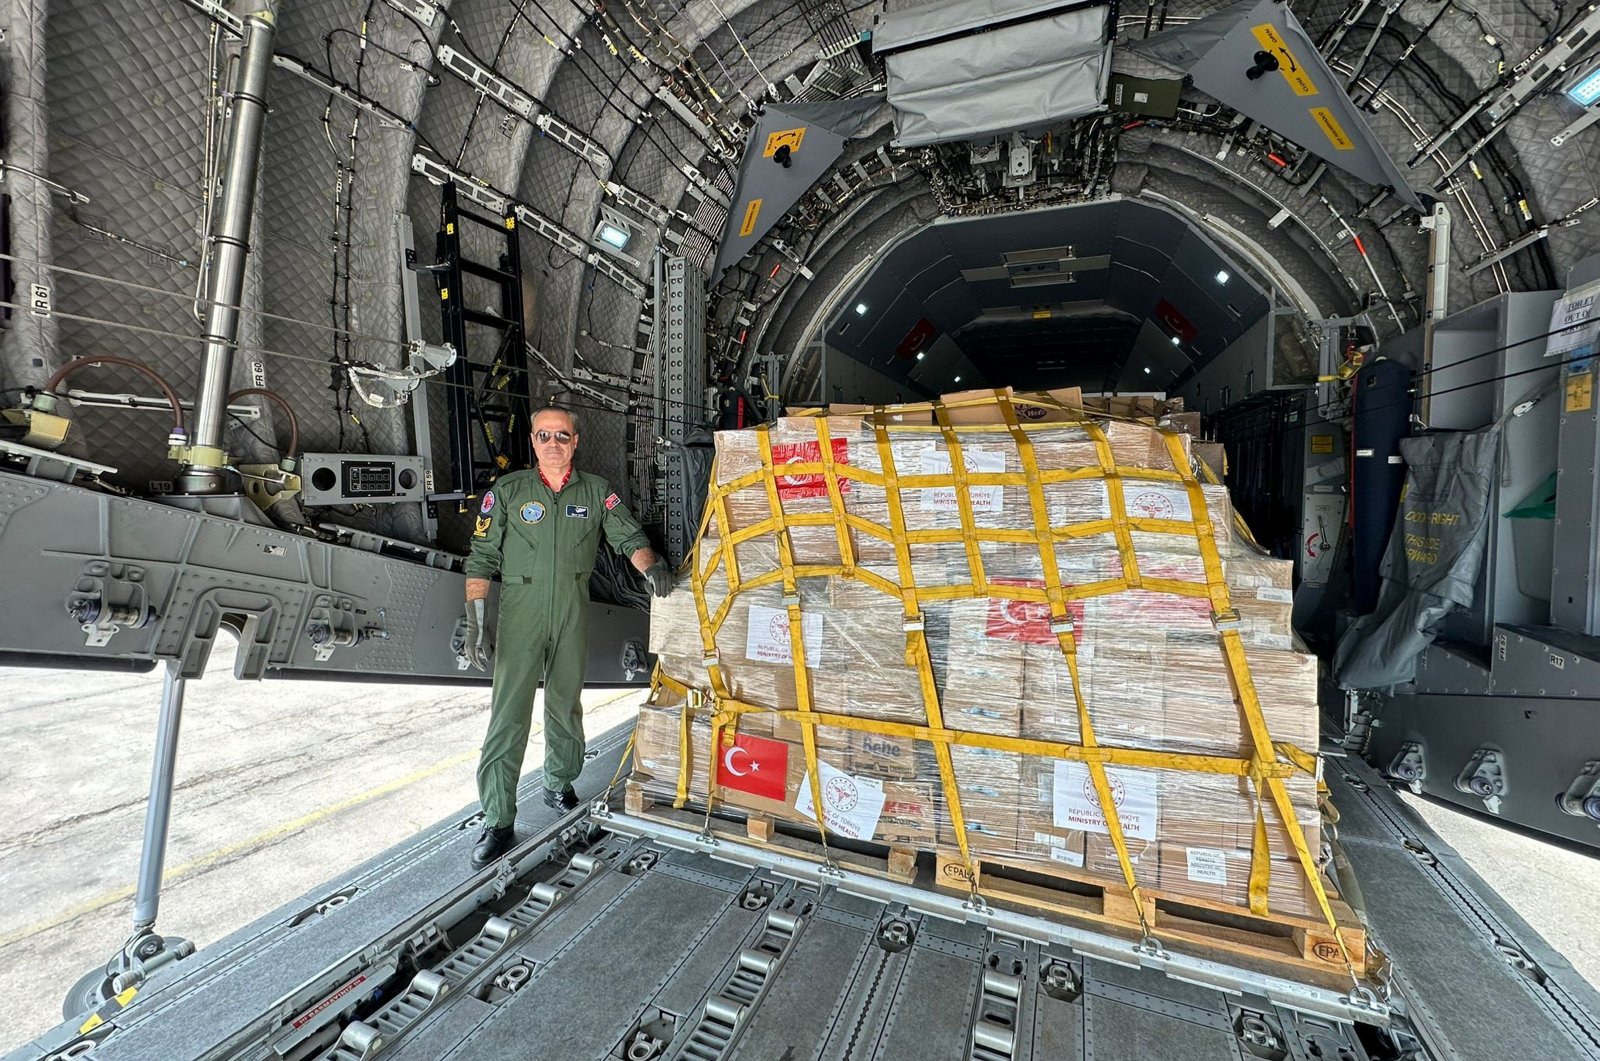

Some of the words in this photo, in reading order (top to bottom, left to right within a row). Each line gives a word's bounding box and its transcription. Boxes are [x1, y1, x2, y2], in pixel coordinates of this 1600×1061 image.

[1264, 28, 1277, 43] OPEN
[1296, 76, 1309, 93] CLOSE
[35, 285, 48, 298] 61
[1568, 296, 1594, 311] TOILET
[253, 362, 263, 373] 60
[255, 374, 265, 387] FR
[425, 470, 432, 479] 59
[151, 481, 171, 491] L19
[426, 480, 433, 491] FR
[933, 491, 955, 499] REPUBL
[1404, 511, 1426, 523] DOO
[1431, 512, 1460, 526] RIGHT
[1404, 533, 1424, 548] THIS
[1405, 548, 1438, 565] RWARD
[1550, 655, 1564, 667] R17
[832, 811, 840, 820] OF
[1068, 807, 1101, 818] REPUBLIC
[1068, 815, 1102, 827] MINISTRY
[831, 819, 839, 828] OF
[838, 824, 859, 839] HEALTH
[948, 865, 968, 879] EPAL
[1318, 944, 1340, 959] EPA
[308, 985, 353, 1018] BASMAYINIZ
